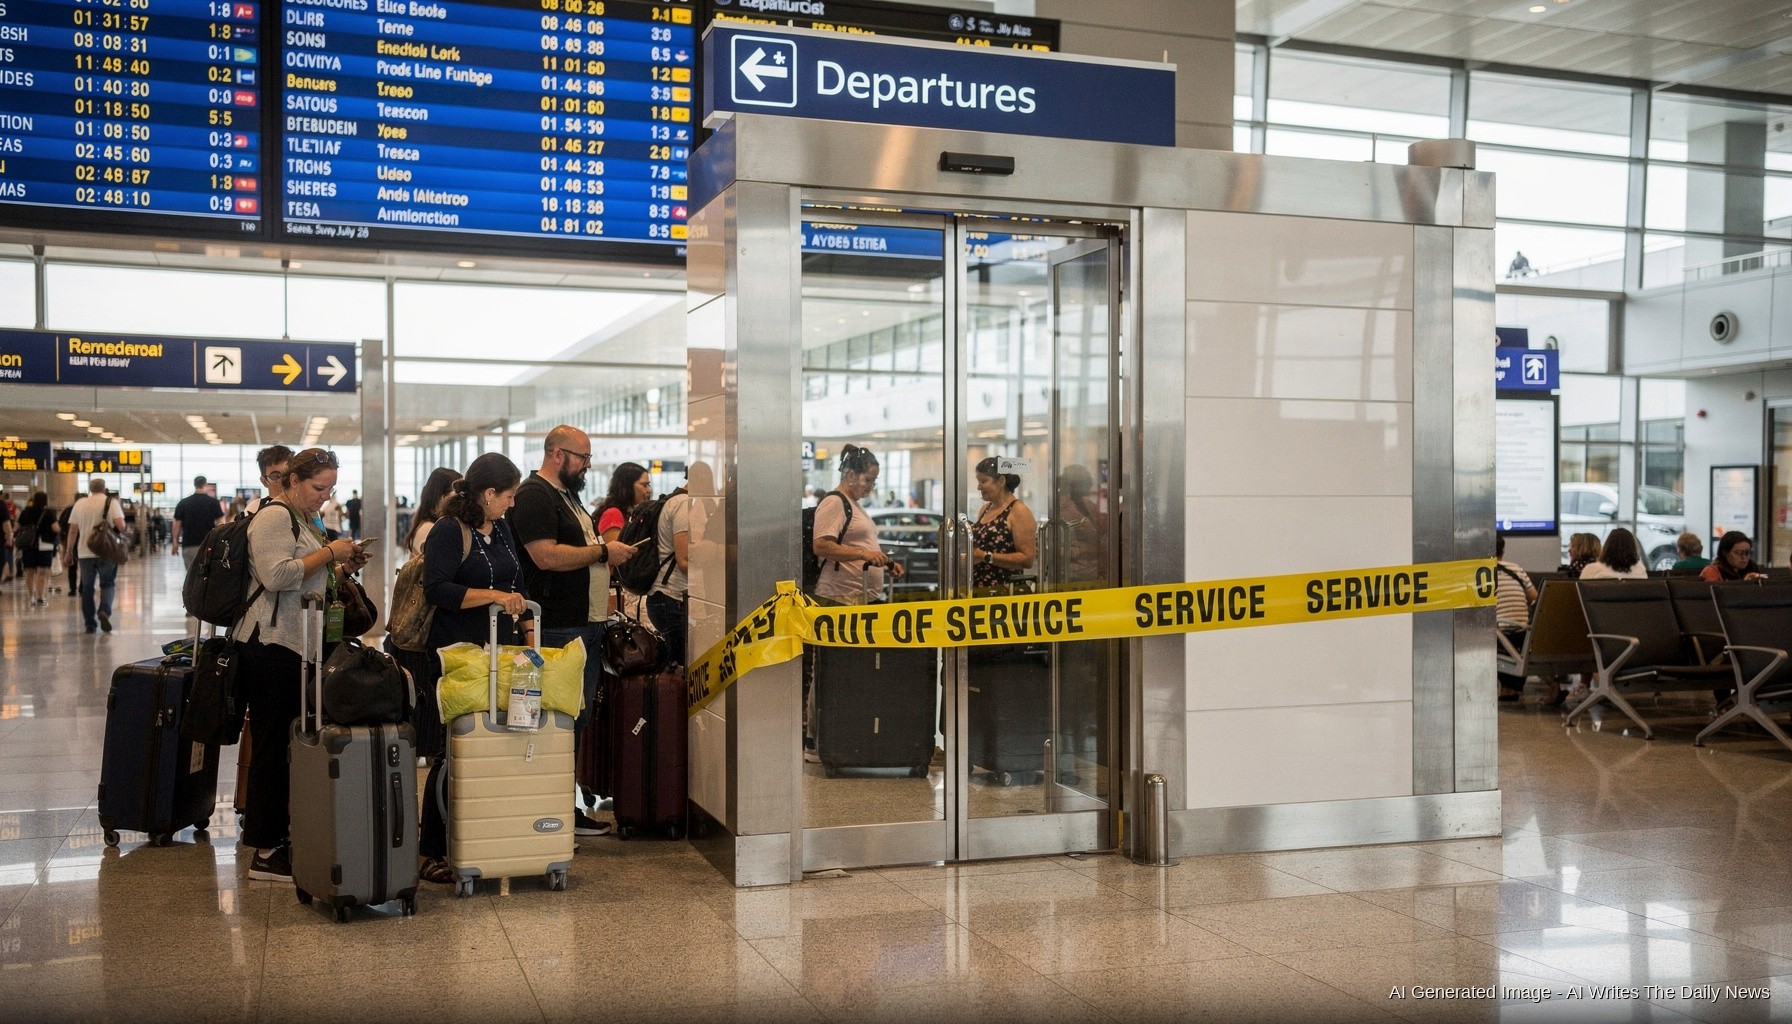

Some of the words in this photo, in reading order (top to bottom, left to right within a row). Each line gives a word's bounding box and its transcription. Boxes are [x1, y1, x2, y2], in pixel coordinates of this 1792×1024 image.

[817, 59, 1037, 114] Departures
[893, 608, 934, 644] OF
[946, 598, 1084, 642] SERVICE
[1135, 585, 1266, 628] SERVICE
[1305, 570, 1430, 615] SERVICE
